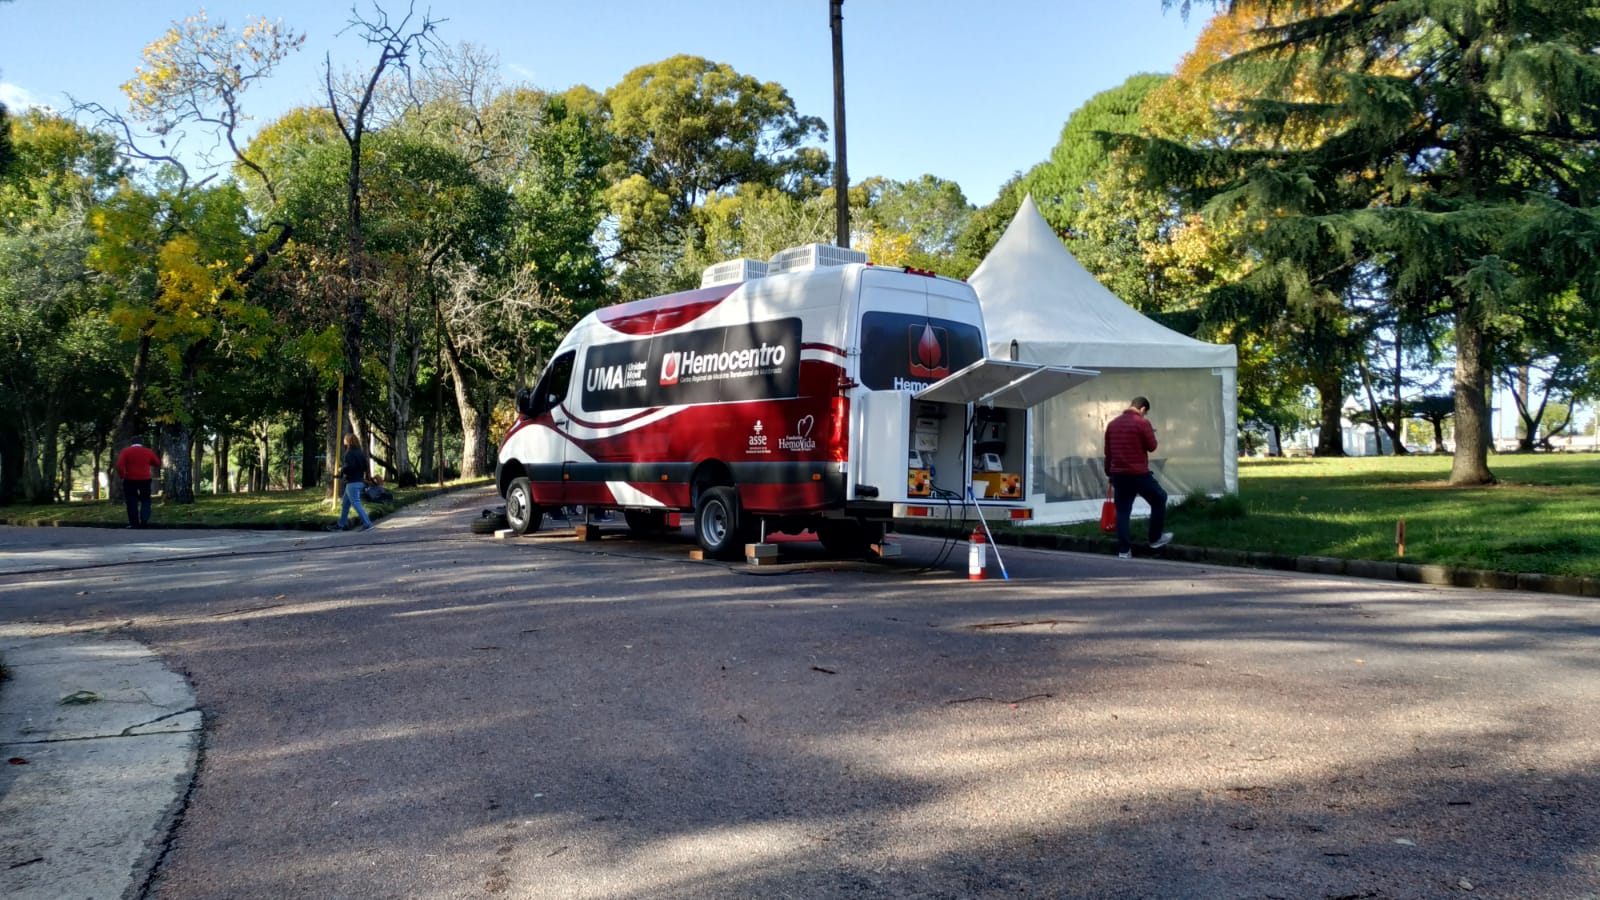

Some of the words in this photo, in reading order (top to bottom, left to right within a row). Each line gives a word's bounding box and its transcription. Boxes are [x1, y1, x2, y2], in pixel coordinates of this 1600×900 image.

[681, 342, 786, 375] Hemocentro
[587, 364, 624, 392] UMA
[894, 376, 932, 393] Hemo
[748, 435, 768, 446] asse
[778, 437, 816, 449] HemoVida
